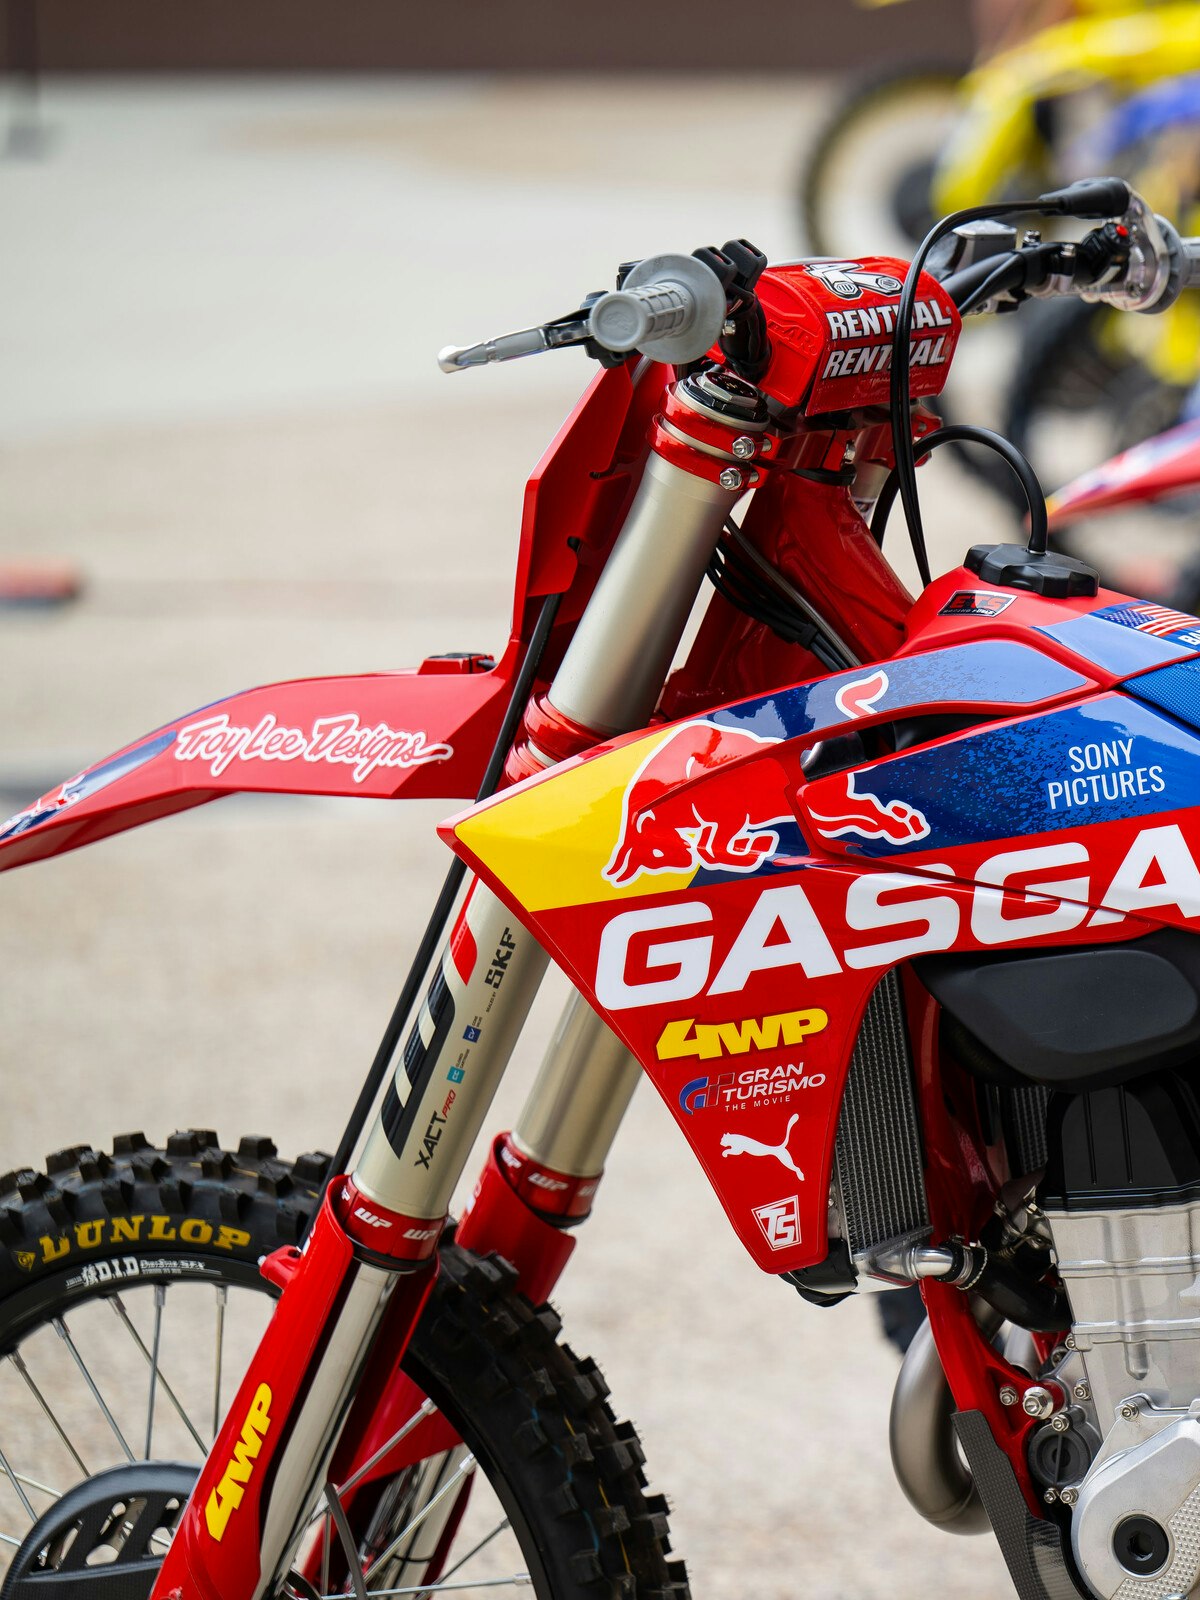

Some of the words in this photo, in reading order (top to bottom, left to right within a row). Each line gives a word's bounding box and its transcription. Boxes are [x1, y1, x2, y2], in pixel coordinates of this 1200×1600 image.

[825, 299, 952, 341] RENTAL
[822, 336, 946, 380] RENTAL
[175, 713, 251, 777] Troy
[238, 713, 308, 761] Lee
[302, 712, 455, 784] Designs
[1068, 738, 1134, 773] SONY
[1047, 765, 1166, 810] PICTURES
[484, 926, 517, 990] SKF
[655, 1007, 829, 1061] 4WP
[722, 1072, 827, 1103] TURISMO
[738, 1061, 804, 1086] GRAN
[724, 1104, 748, 1113] THE
[753, 1094, 791, 1108] MOVIE
[413, 1110, 448, 1171] XACT
[441, 1089, 457, 1119] PRO
[353, 1206, 394, 1229] WP
[401, 1227, 438, 1241] WP
[205, 1382, 273, 1542] 4WP
